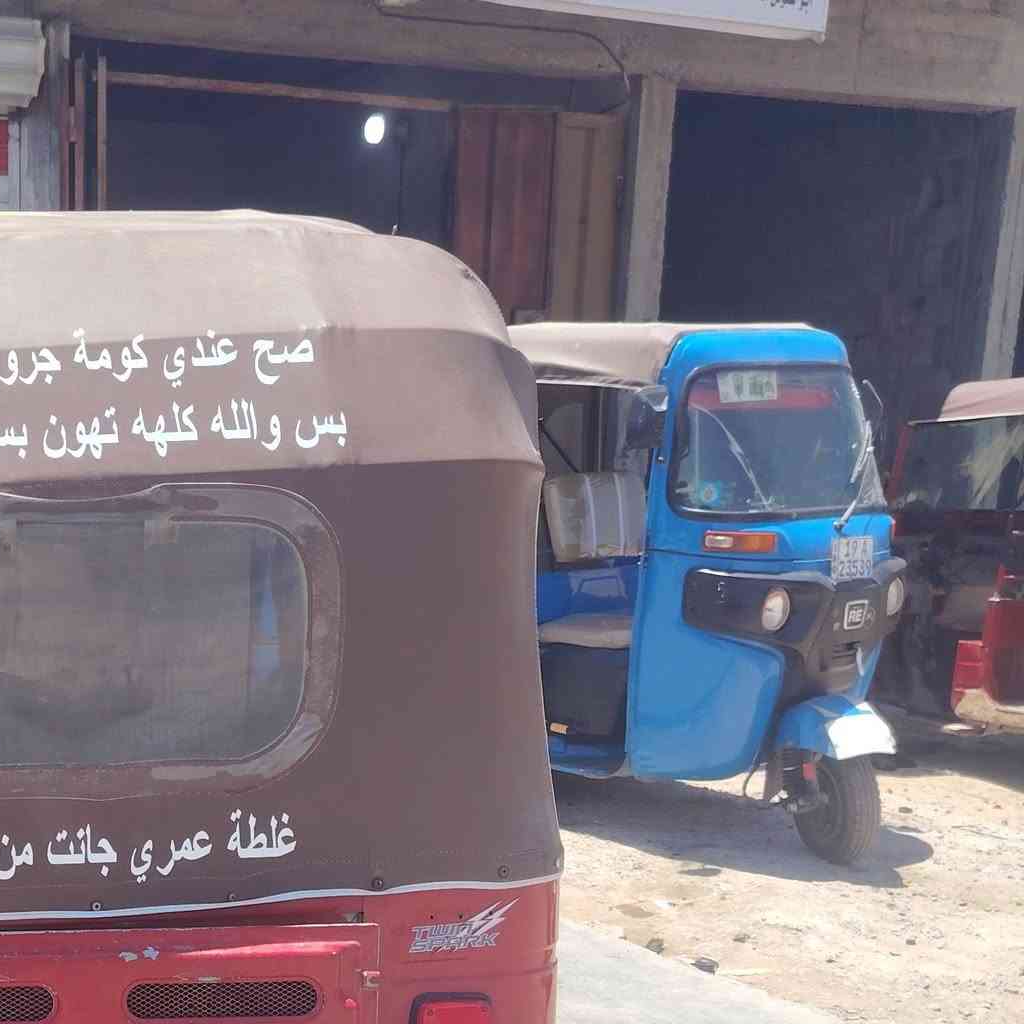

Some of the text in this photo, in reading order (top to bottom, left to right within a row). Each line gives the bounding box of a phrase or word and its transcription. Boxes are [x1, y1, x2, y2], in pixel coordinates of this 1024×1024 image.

[73, 328, 148, 382] كومة
[164, 329, 238, 388] عندي
[253, 338, 313, 384] صح
[43, 406, 119, 459] تهون
[132, 401, 198, 457] كلهه
[210, 398, 281, 450] والله
[295, 411, 347, 448] بس
[47, 823, 117, 876] جانت
[130, 830, 212, 883] عمري
[226, 808, 296, 859] غلطة
